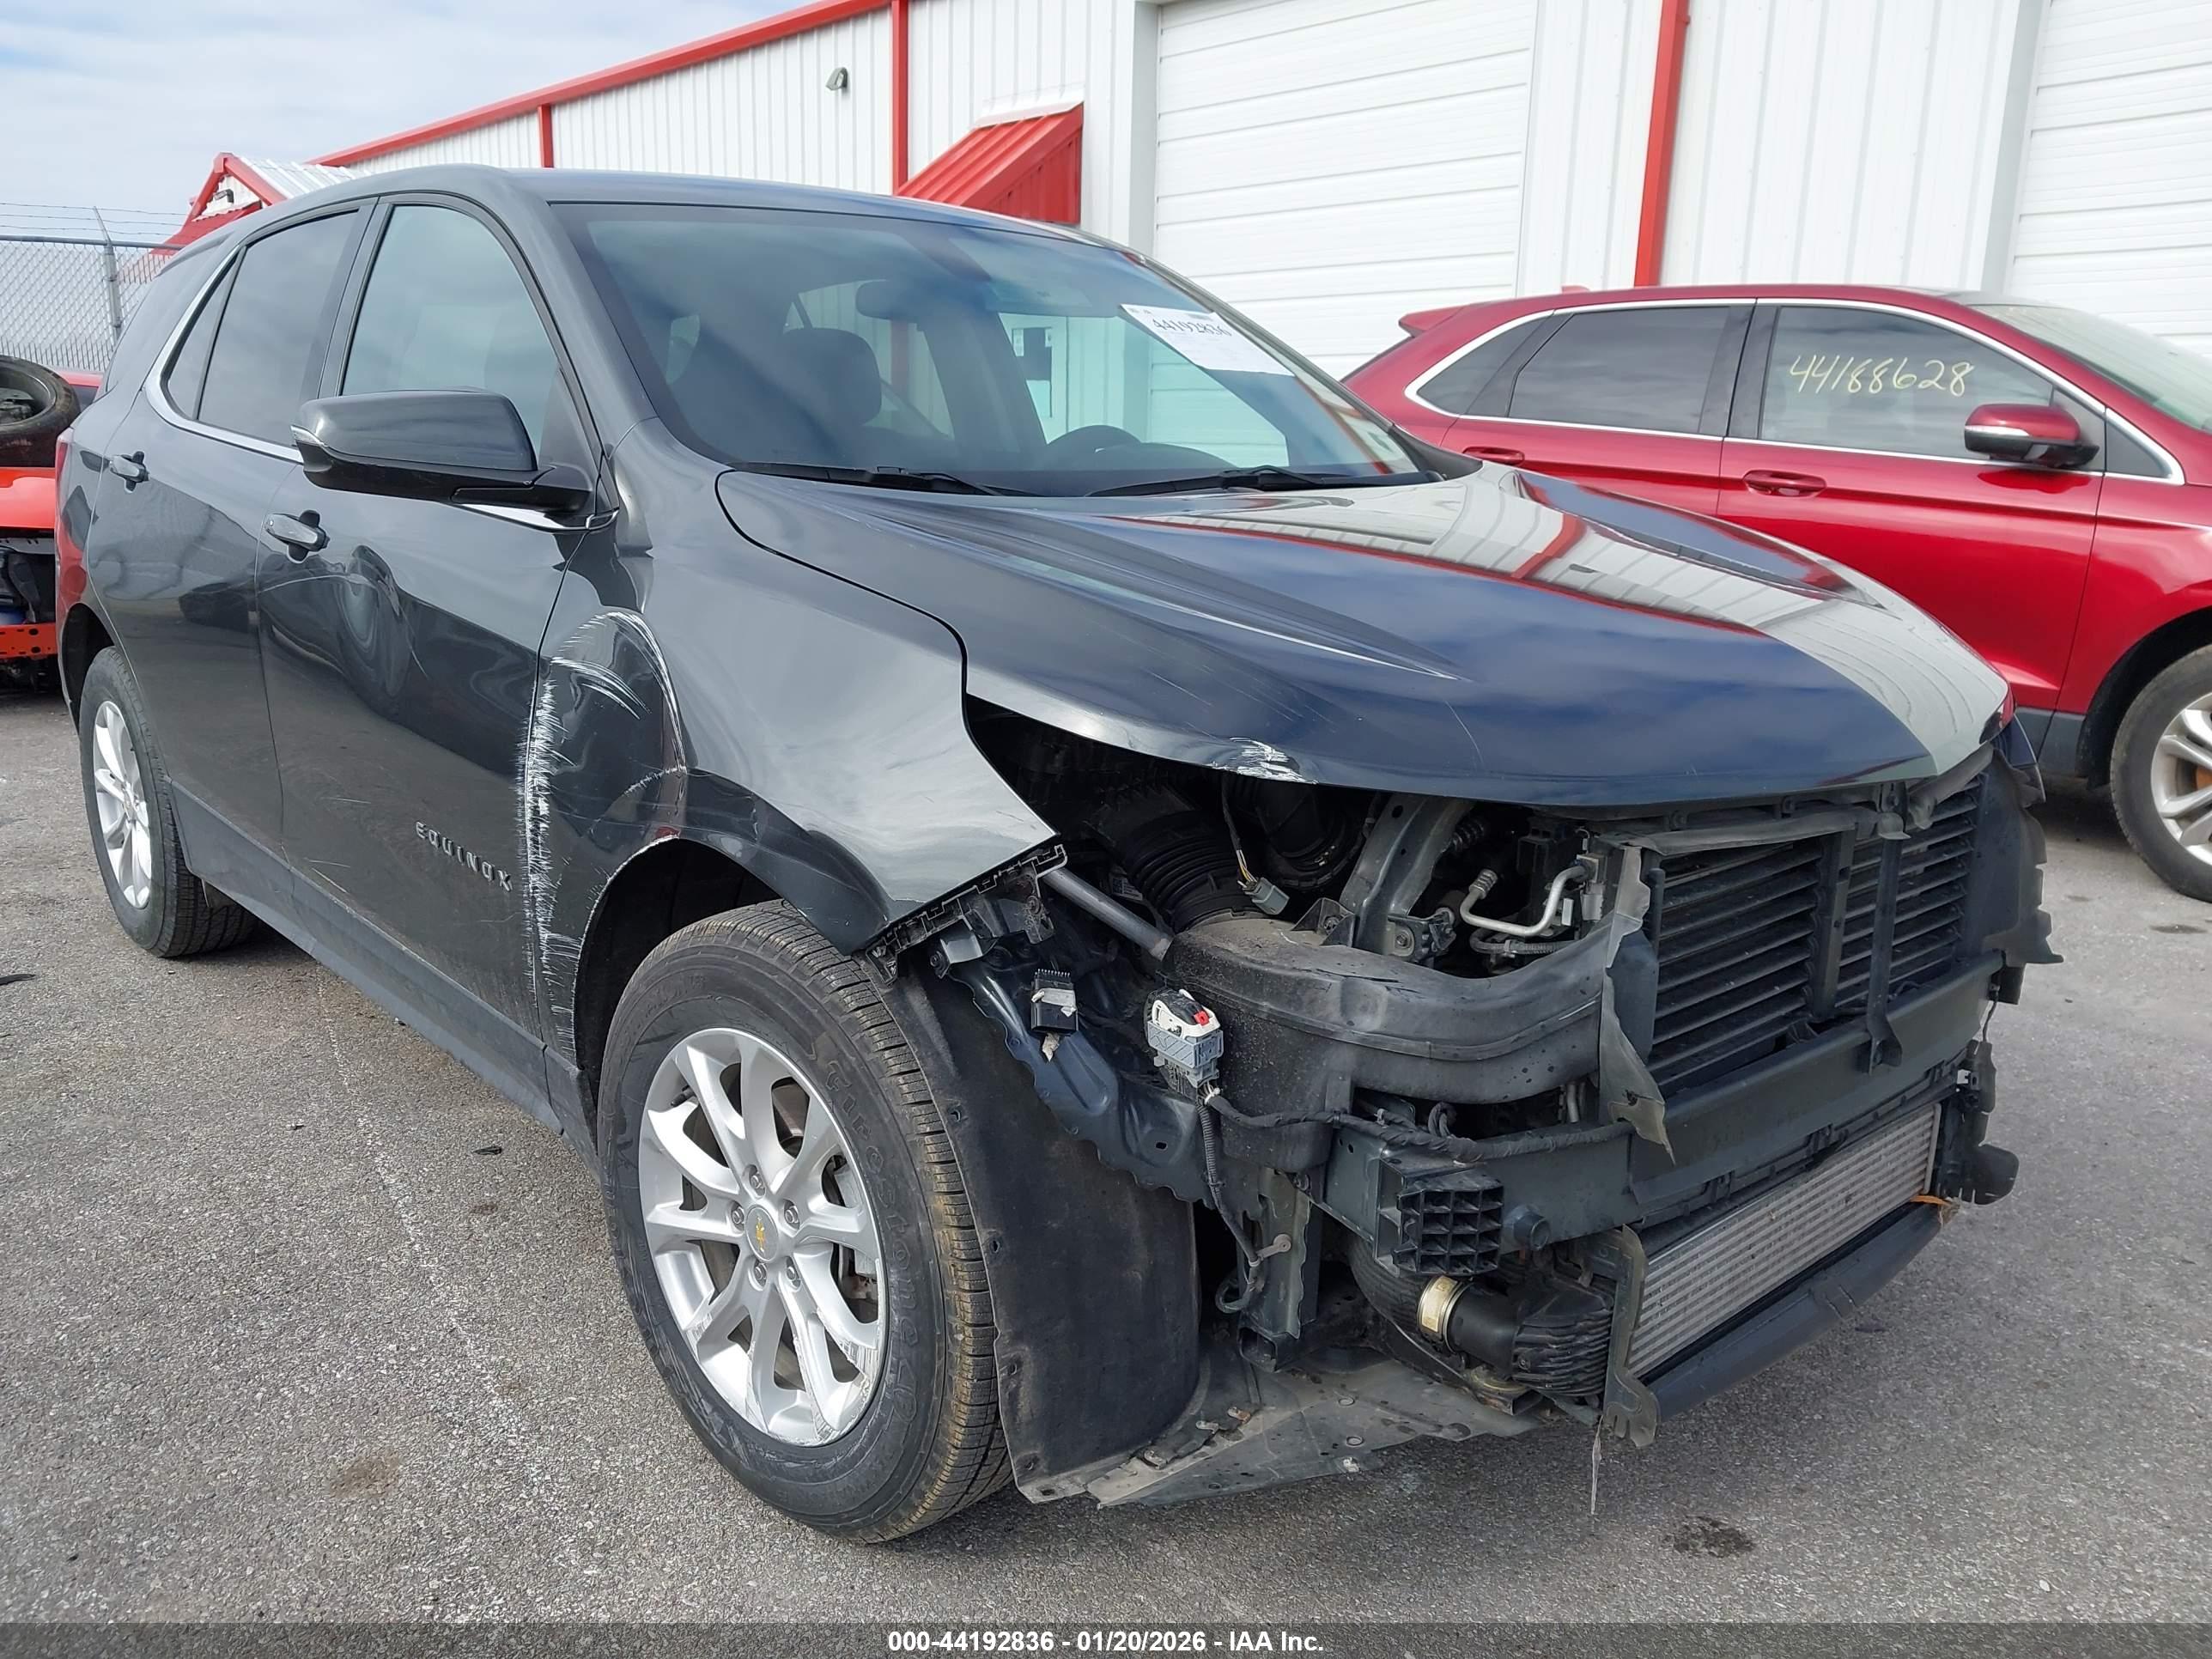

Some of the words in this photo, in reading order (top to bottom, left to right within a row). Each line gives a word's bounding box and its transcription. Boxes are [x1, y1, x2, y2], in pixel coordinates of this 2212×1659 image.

[1152, 318, 1233, 337] 44192836
[1790, 354, 1975, 397] 44188628
[415, 821, 514, 892] EQUINOX
